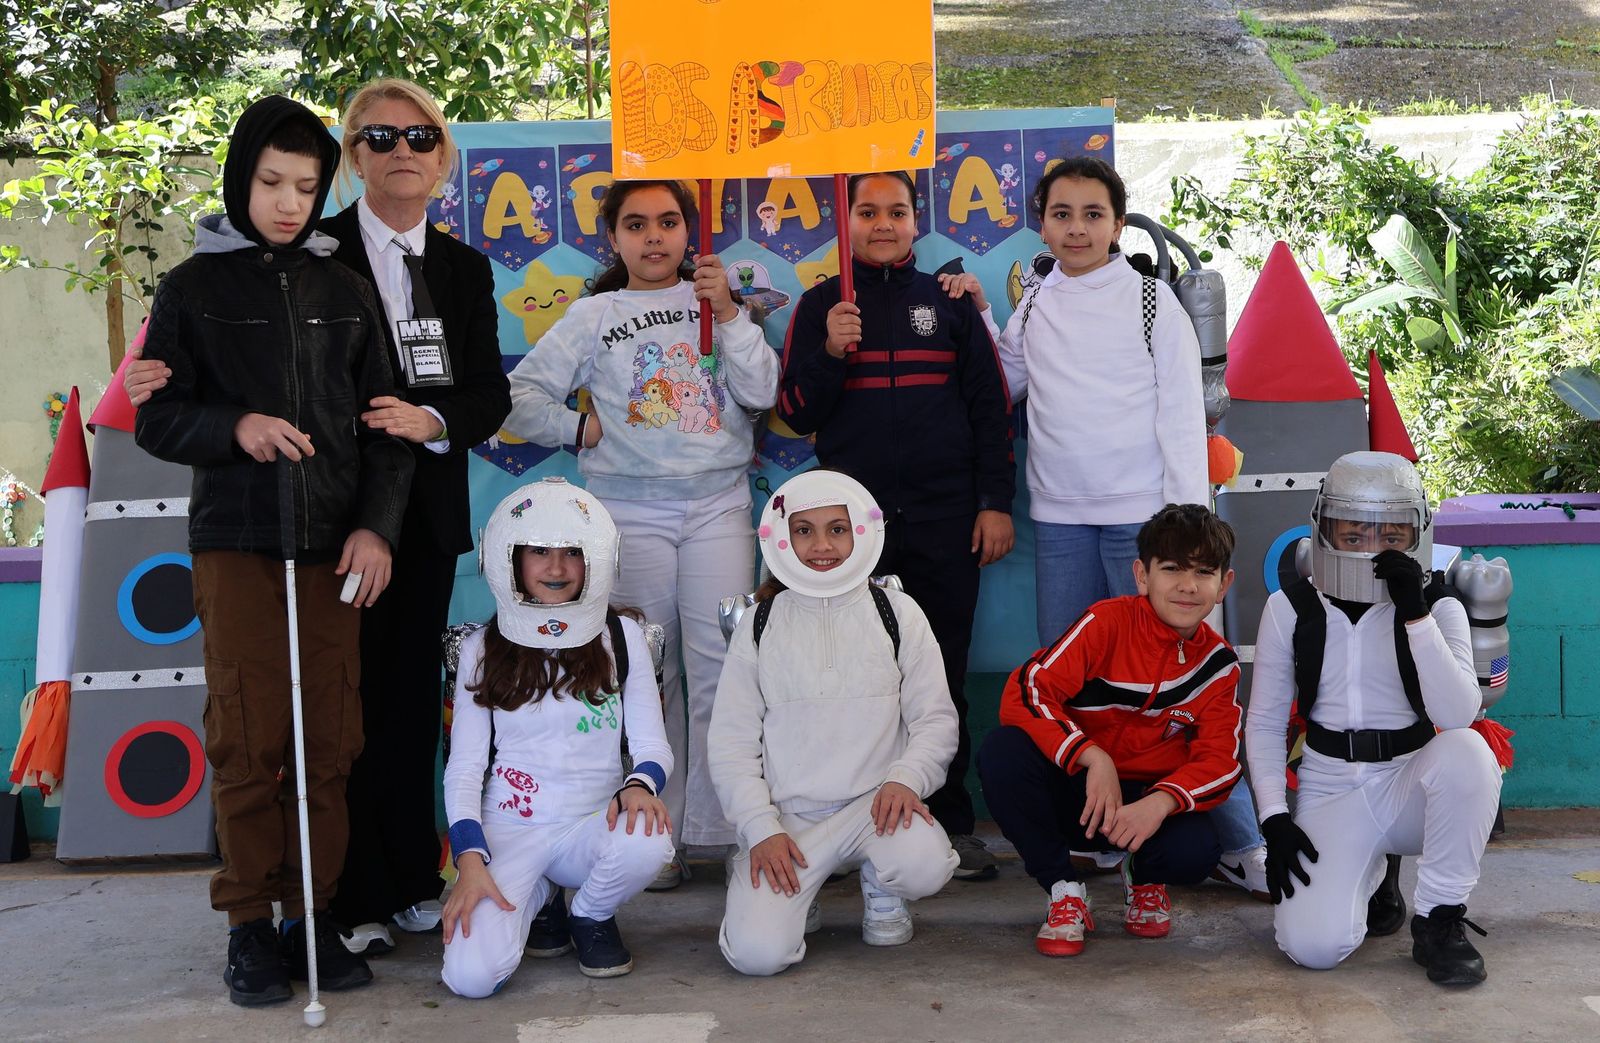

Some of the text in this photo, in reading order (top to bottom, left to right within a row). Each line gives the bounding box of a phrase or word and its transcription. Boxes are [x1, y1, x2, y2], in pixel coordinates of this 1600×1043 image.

[619, 60, 718, 163] LOS
[601, 322, 634, 350] My
[631, 309, 685, 331] Little
